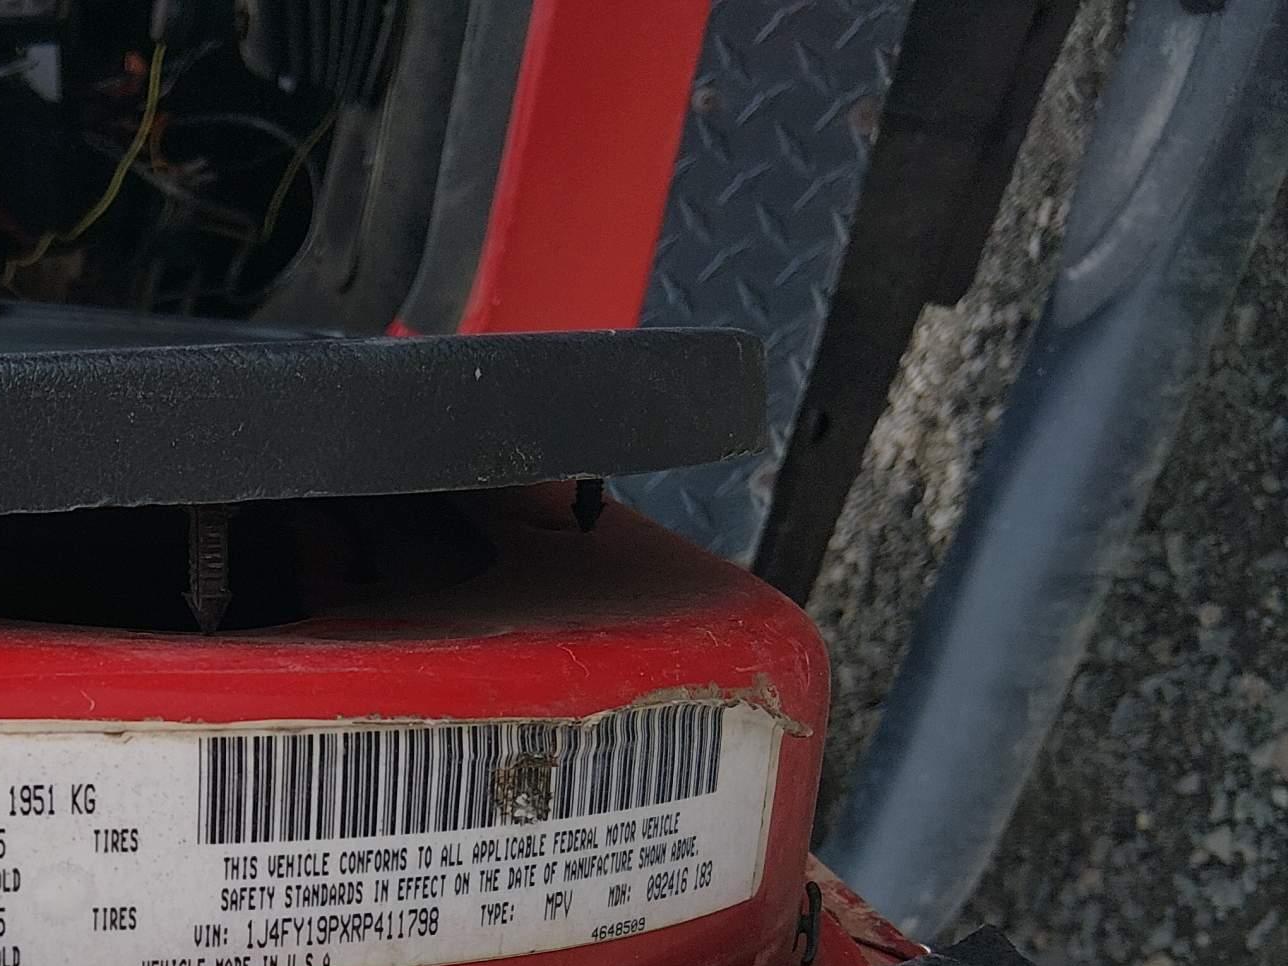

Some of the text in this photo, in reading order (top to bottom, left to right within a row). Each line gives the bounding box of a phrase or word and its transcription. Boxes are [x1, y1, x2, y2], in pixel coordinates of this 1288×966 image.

[9, 784, 56, 817] 1951
[70, 783, 97, 816] KG
[94, 829, 139, 853] TIRES
[223, 812, 681, 880] THIS VEHICLE CONFORMS TO ALL APPLICABLE FEDERAL MOTOR VEHICLE
[220, 835, 700, 912] SAFETY STANDARDS IN EFFECT ON THE DATE OF MANUFACTURE SHOWN ABOVE.
[92, 907, 137, 931] TIRES
[194, 860, 714, 950] VIN: 1J4FY19PXRP411798 TYPE: MPV MDH: 092416 183
[591, 916, 647, 942] 4648509
